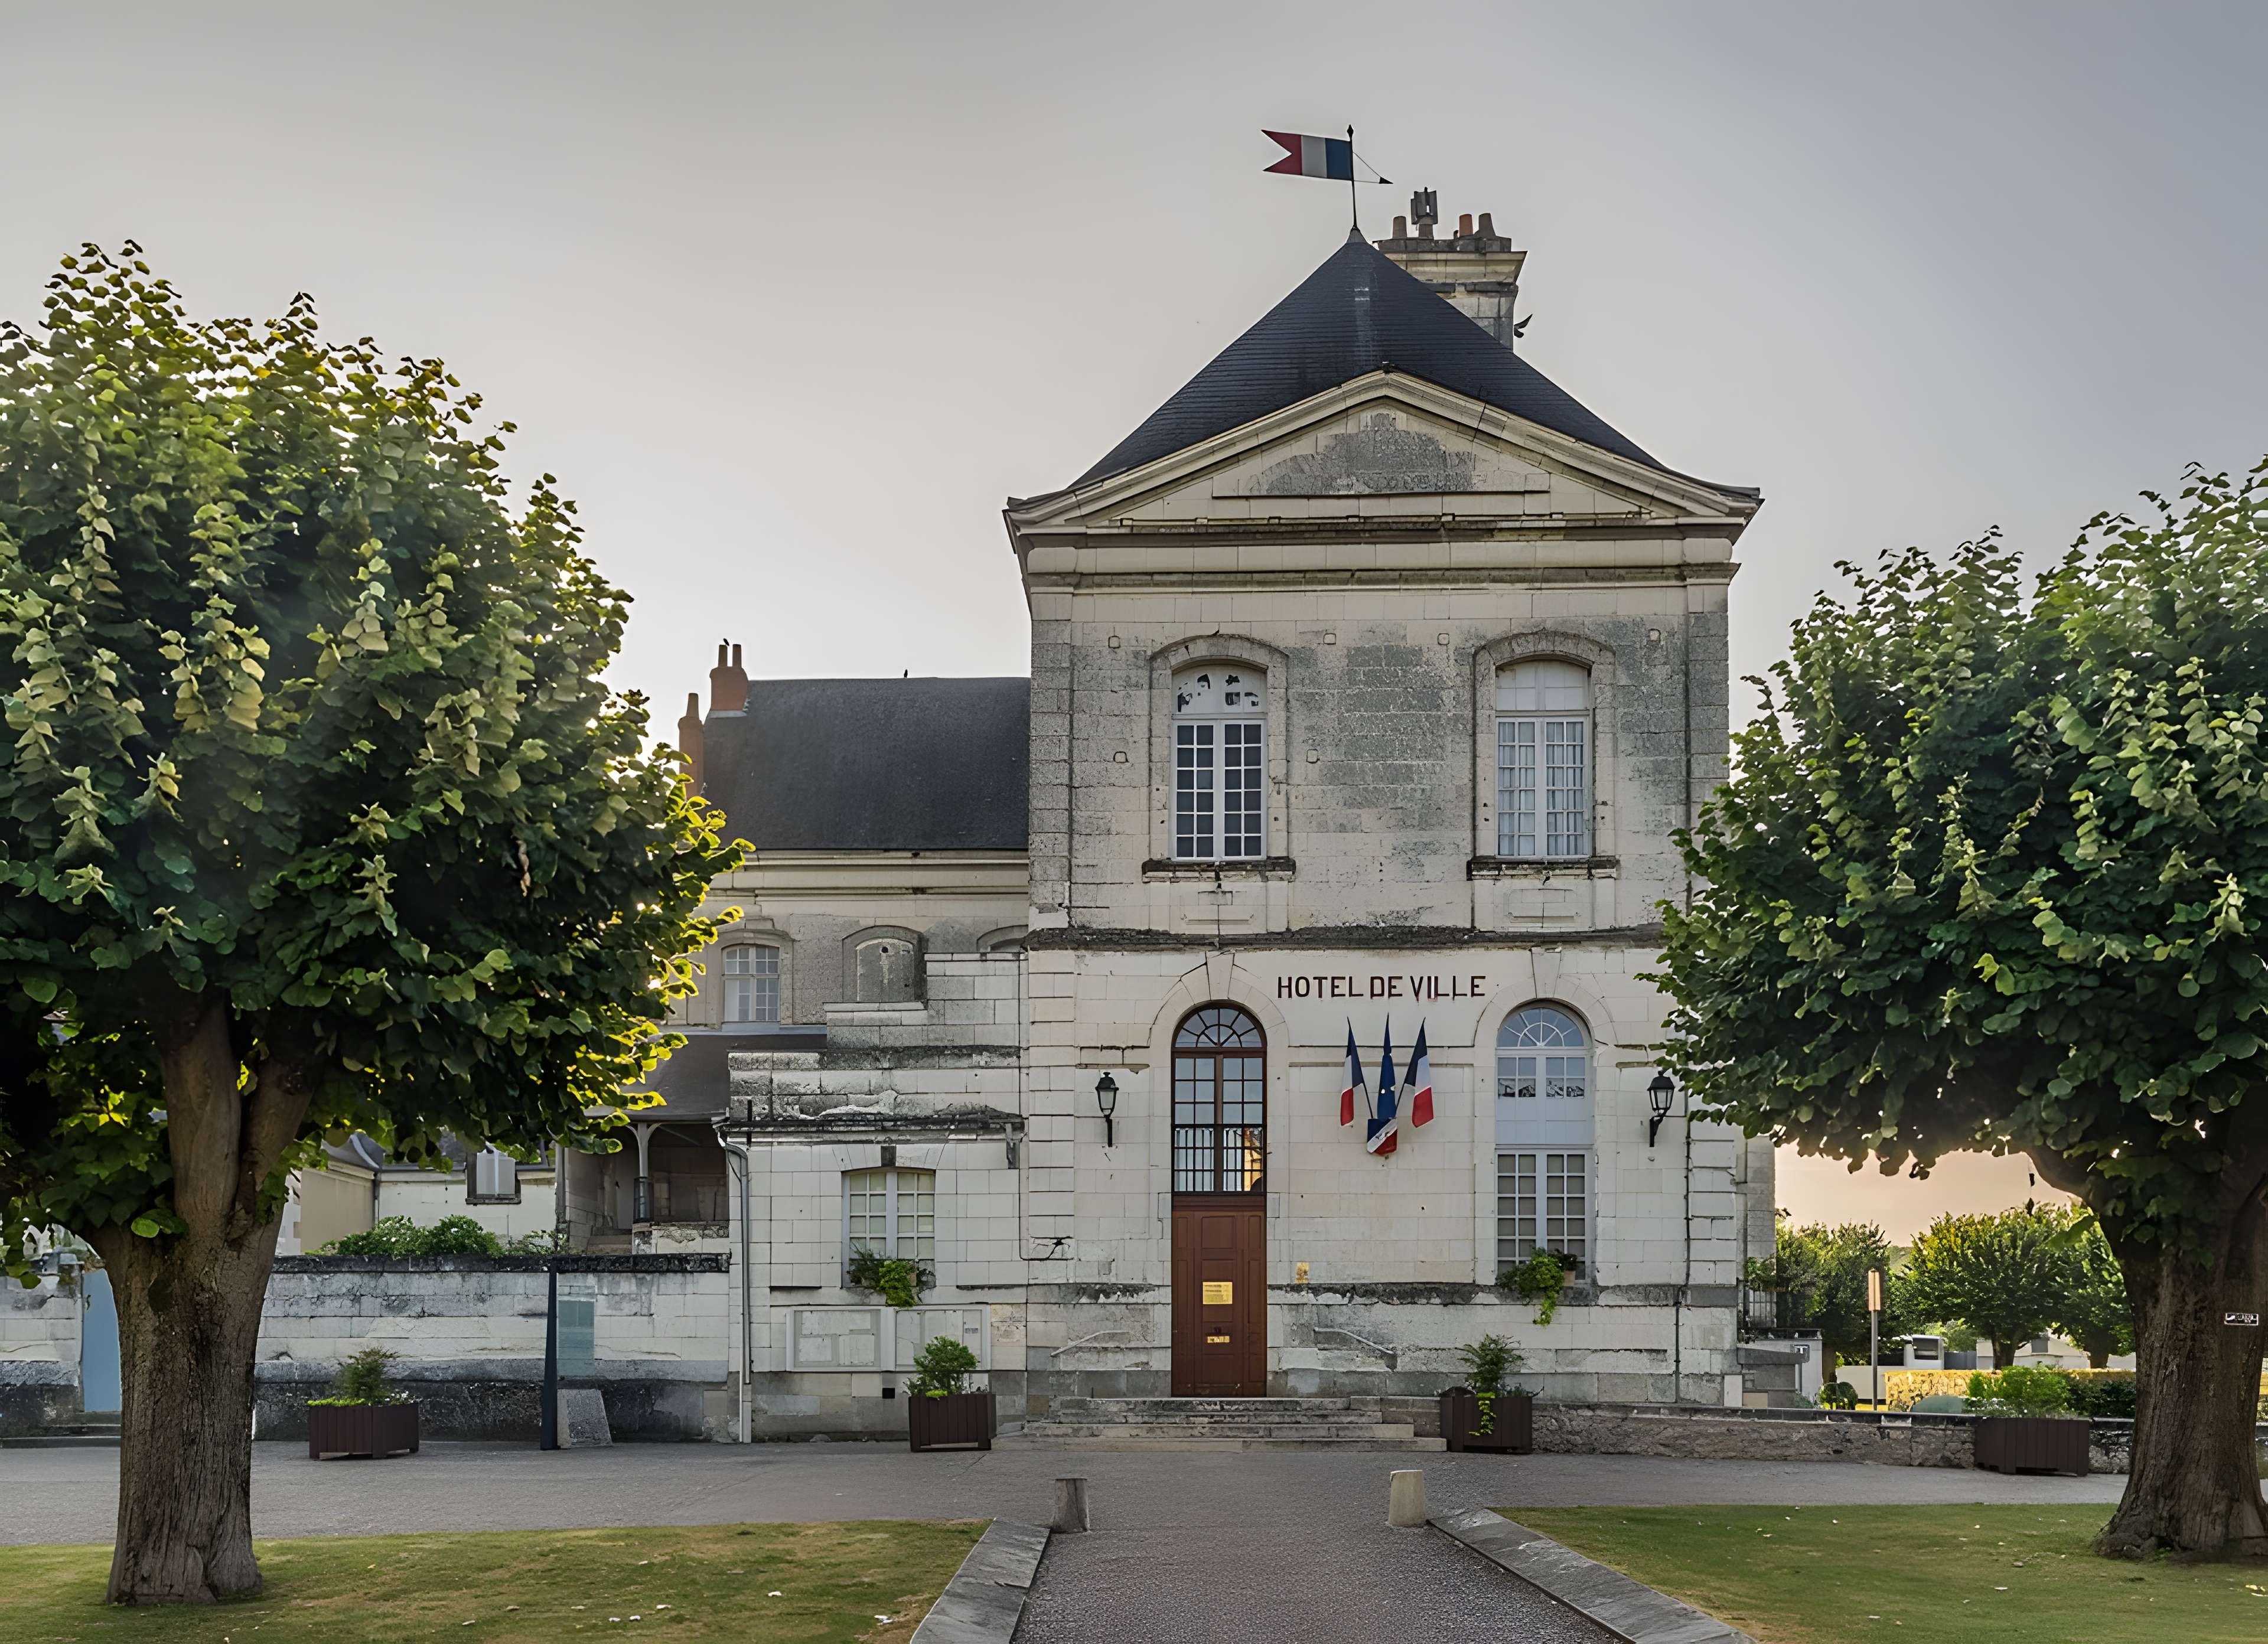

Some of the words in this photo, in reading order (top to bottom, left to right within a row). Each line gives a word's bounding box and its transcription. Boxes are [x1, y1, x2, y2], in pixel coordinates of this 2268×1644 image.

[1278, 976, 1364, 999] HOTEL
[1370, 976, 1403, 999] DE
[1410, 976, 1486, 1000] VILLE
